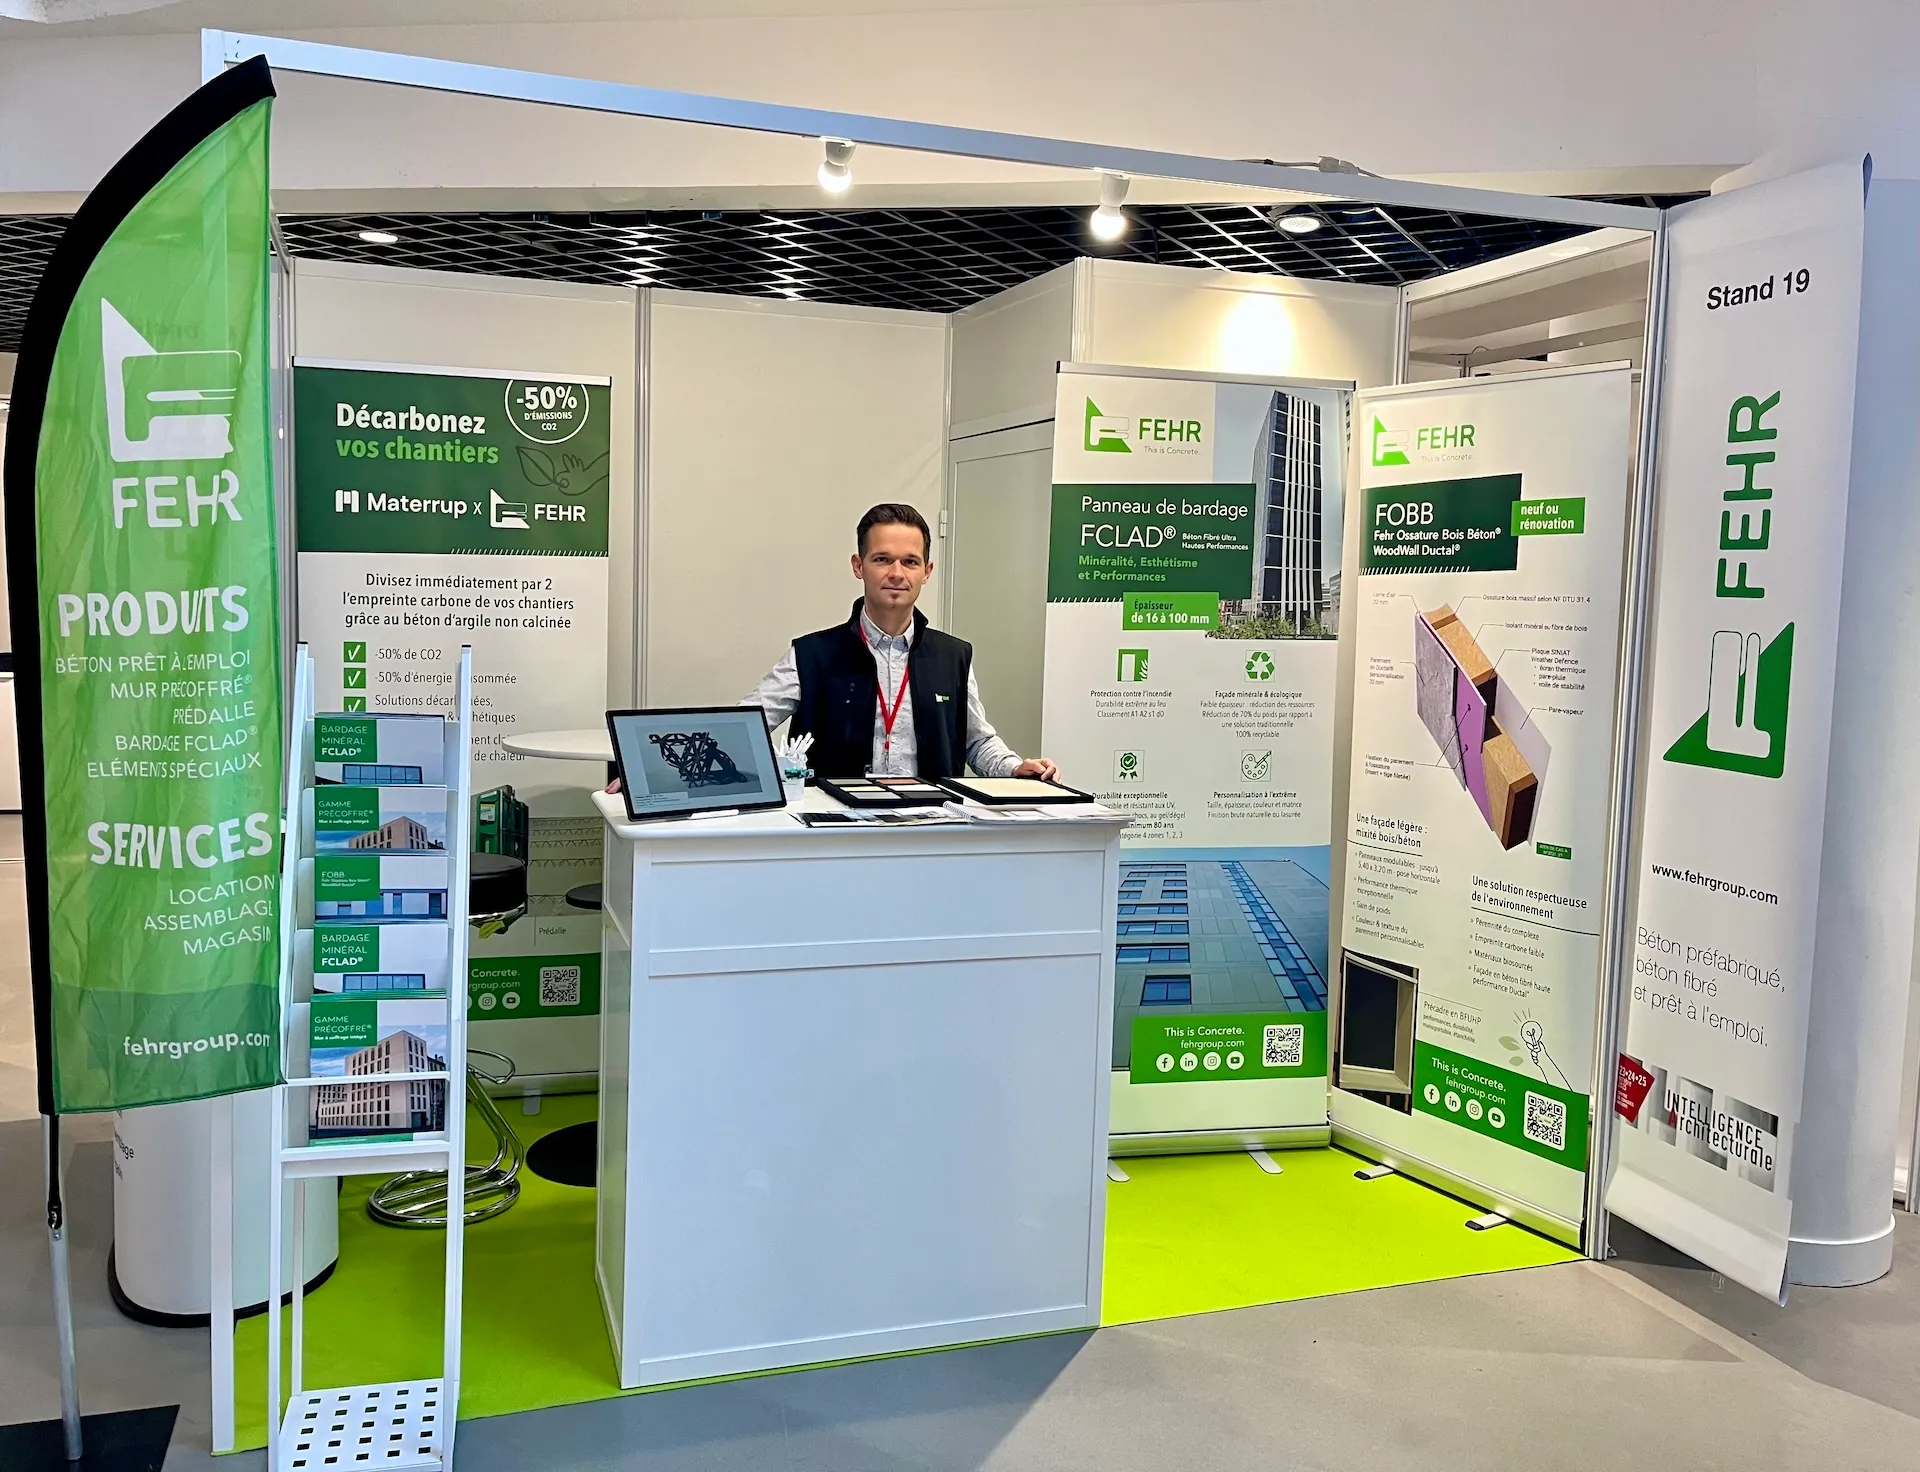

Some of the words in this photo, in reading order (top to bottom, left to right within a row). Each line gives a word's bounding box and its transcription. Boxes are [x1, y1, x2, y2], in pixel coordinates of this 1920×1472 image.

[1706, 276, 1774, 310] Stand
[1782, 268, 1810, 296] 19
[515, 385, 578, 410] -50%
[336, 402, 485, 435] Décarbonez
[524, 410, 573, 421] D'ÉMISSIONS
[541, 422, 557, 431] CO2
[1139, 417, 1201, 443] FEHR
[1417, 424, 1475, 450] FEHR
[336, 439, 379, 458] vos
[384, 435, 499, 464] chantiers
[112, 469, 242, 529] FEHR
[1716, 390, 1781, 599] FEHR
[367, 492, 468, 519] Materrup
[534, 503, 586, 522] FEHR
[1081, 495, 1150, 514] Panneau
[1156, 498, 1176, 515] de
[1182, 498, 1248, 521] bardage
[1375, 502, 1434, 526] FOBB
[1520, 502, 1544, 515] neuf
[1546, 505, 1559, 514] ou
[1520, 517, 1575, 530] rénovation
[1081, 524, 1177, 548] FCLAD®
[1182, 533, 1202, 541] Béton
[1203, 533, 1220, 541] Fibré
[1373, 529, 1394, 541] Fehr
[1396, 529, 1439, 541] Ossature
[1441, 528, 1465, 540] Bois
[1373, 544, 1419, 556] WoodWall
[1079, 555, 1137, 568] Minéralité,
[1140, 557, 1198, 568] Esthétisme
[366, 573, 412, 587] Divisez
[415, 575, 518, 589] immédiatement
[521, 580, 541, 593] par
[545, 578, 552, 590] 2
[1078, 571, 1090, 580] et
[1093, 570, 1166, 582] Performances
[343, 591, 417, 609] l'empreinte
[421, 594, 471, 607] carbone
[475, 595, 490, 608] de
[494, 598, 515, 608] vos
[518, 596, 574, 610] chantiers
[1134, 599, 1173, 611] Épaisseur
[345, 612, 380, 628] grâce
[384, 615, 399, 625] au
[403, 612, 440, 626] béton
[444, 613, 491, 630] d'argile
[495, 617, 518, 628] non
[522, 615, 571, 629] calcinée
[1131, 613, 1143, 623] de
[1146, 613, 1158, 623] 16
[1160, 613, 1165, 623] à
[1168, 613, 1188, 623] 100
[1190, 615, 1209, 624] mm
[56, 653, 112, 674] BÉTON
[119, 652, 167, 672] PRÊT
[404, 648, 417, 660] de
[420, 649, 442, 660] CO2
[404, 671, 452, 686] d'énergie
[470, 673, 517, 684] sommée
[111, 682, 156, 699] MUR
[1215, 690, 1235, 699] Façade
[1270, 690, 1302, 699] écologique
[375, 694, 423, 706] Solutions
[426, 694, 493, 708] décarées,
[173, 700, 256, 725] PRÉDALLE
[321, 725, 368, 734] BARDAGE
[115, 735, 180, 751] BARDAGE
[321, 737, 365, 745] MINÉRAL
[168, 752, 262, 779] SPÉCIAUX
[474, 751, 486, 762] de
[1123, 792, 1168, 800] exceptionnelle
[1356, 812, 1369, 824] Une
[1370, 815, 1395, 829] façade
[1397, 819, 1423, 834] légère
[87, 811, 273, 870] SERVICES
[1355, 828, 1377, 840] mixité
[1378, 832, 1421, 848] bois/béton
[169, 874, 275, 905] LOCATION
[1472, 875, 1488, 888] Une
[1489, 880, 1524, 896] solution
[1525, 889, 1587, 909] respectueuse
[1651, 864, 1778, 905] www.fehrgroup.com
[1471, 890, 1481, 902] de
[1483, 893, 1554, 919] l'environnement
[321, 934, 370, 942] BARDAGE
[321, 945, 367, 954] MINÉRAL
[1638, 926, 1681, 956] Béton
[1686, 946, 1785, 993] préfabriqué,
[471, 968, 520, 979] Concrete.
[1636, 954, 1678, 985] béton
[1684, 970, 1717, 998] fibré
[1633, 985, 1647, 1003] et
[1651, 993, 1682, 1015] prêt
[1686, 1000, 1697, 1021] à
[314, 1015, 349, 1023] GAMME
[1164, 1027, 1184, 1037] This
[1187, 1027, 1194, 1036] is
[1197, 1026, 1245, 1036] Concrete.
[1180, 1039, 1245, 1050] fehrgroup.com
[1431, 1056, 1450, 1072] This
[1451, 1064, 1459, 1075] is
[1461, 1067, 1507, 1092] Concrete.
[1445, 1075, 1506, 1105] fehrgroup.com
[1667, 1089, 1762, 1148] INTELLIGENCE
[1668, 1107, 1773, 1171] Architecturale
